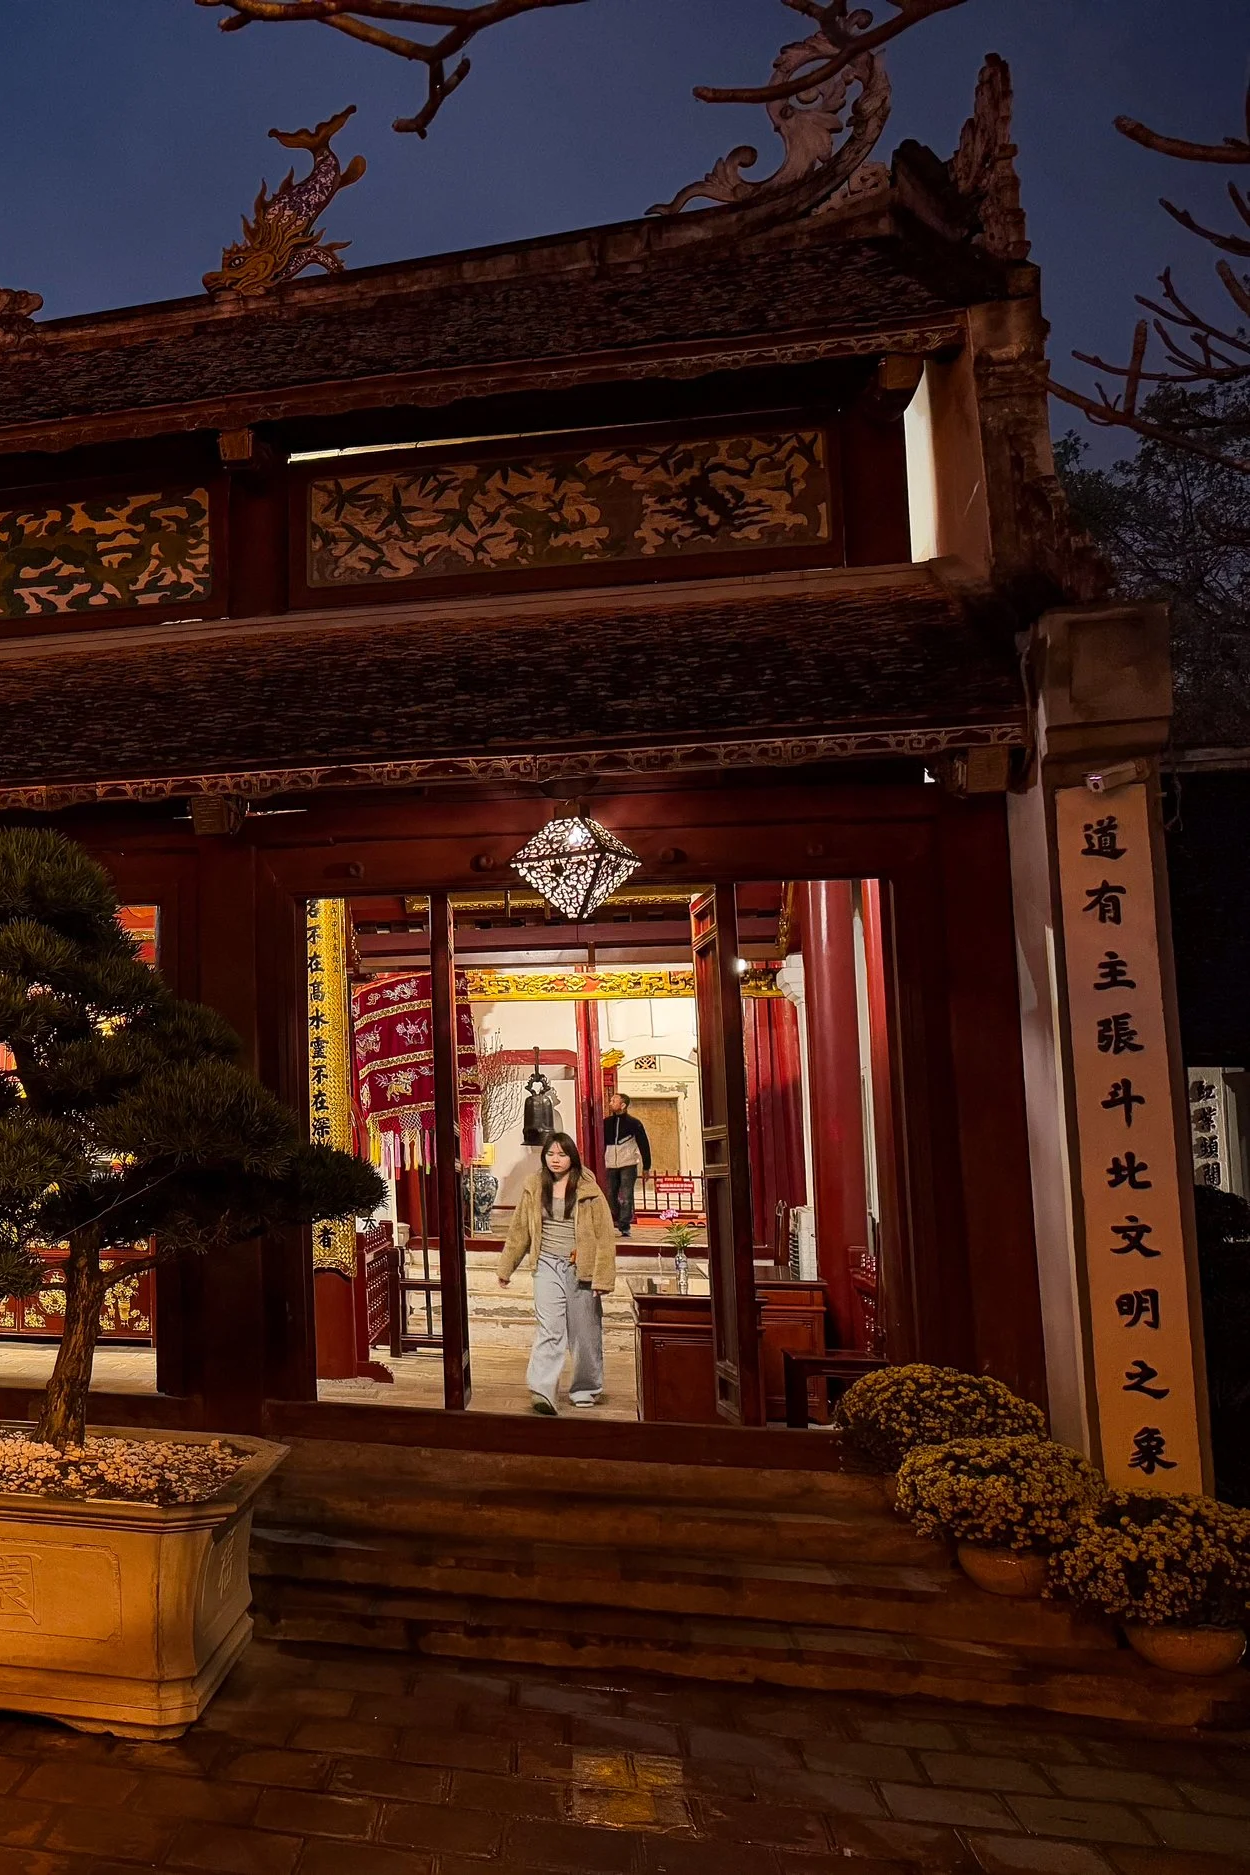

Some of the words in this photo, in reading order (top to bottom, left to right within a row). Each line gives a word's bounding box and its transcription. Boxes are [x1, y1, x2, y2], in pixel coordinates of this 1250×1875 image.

[1081, 816, 1178, 1475] 道有主張斗北文明之象
